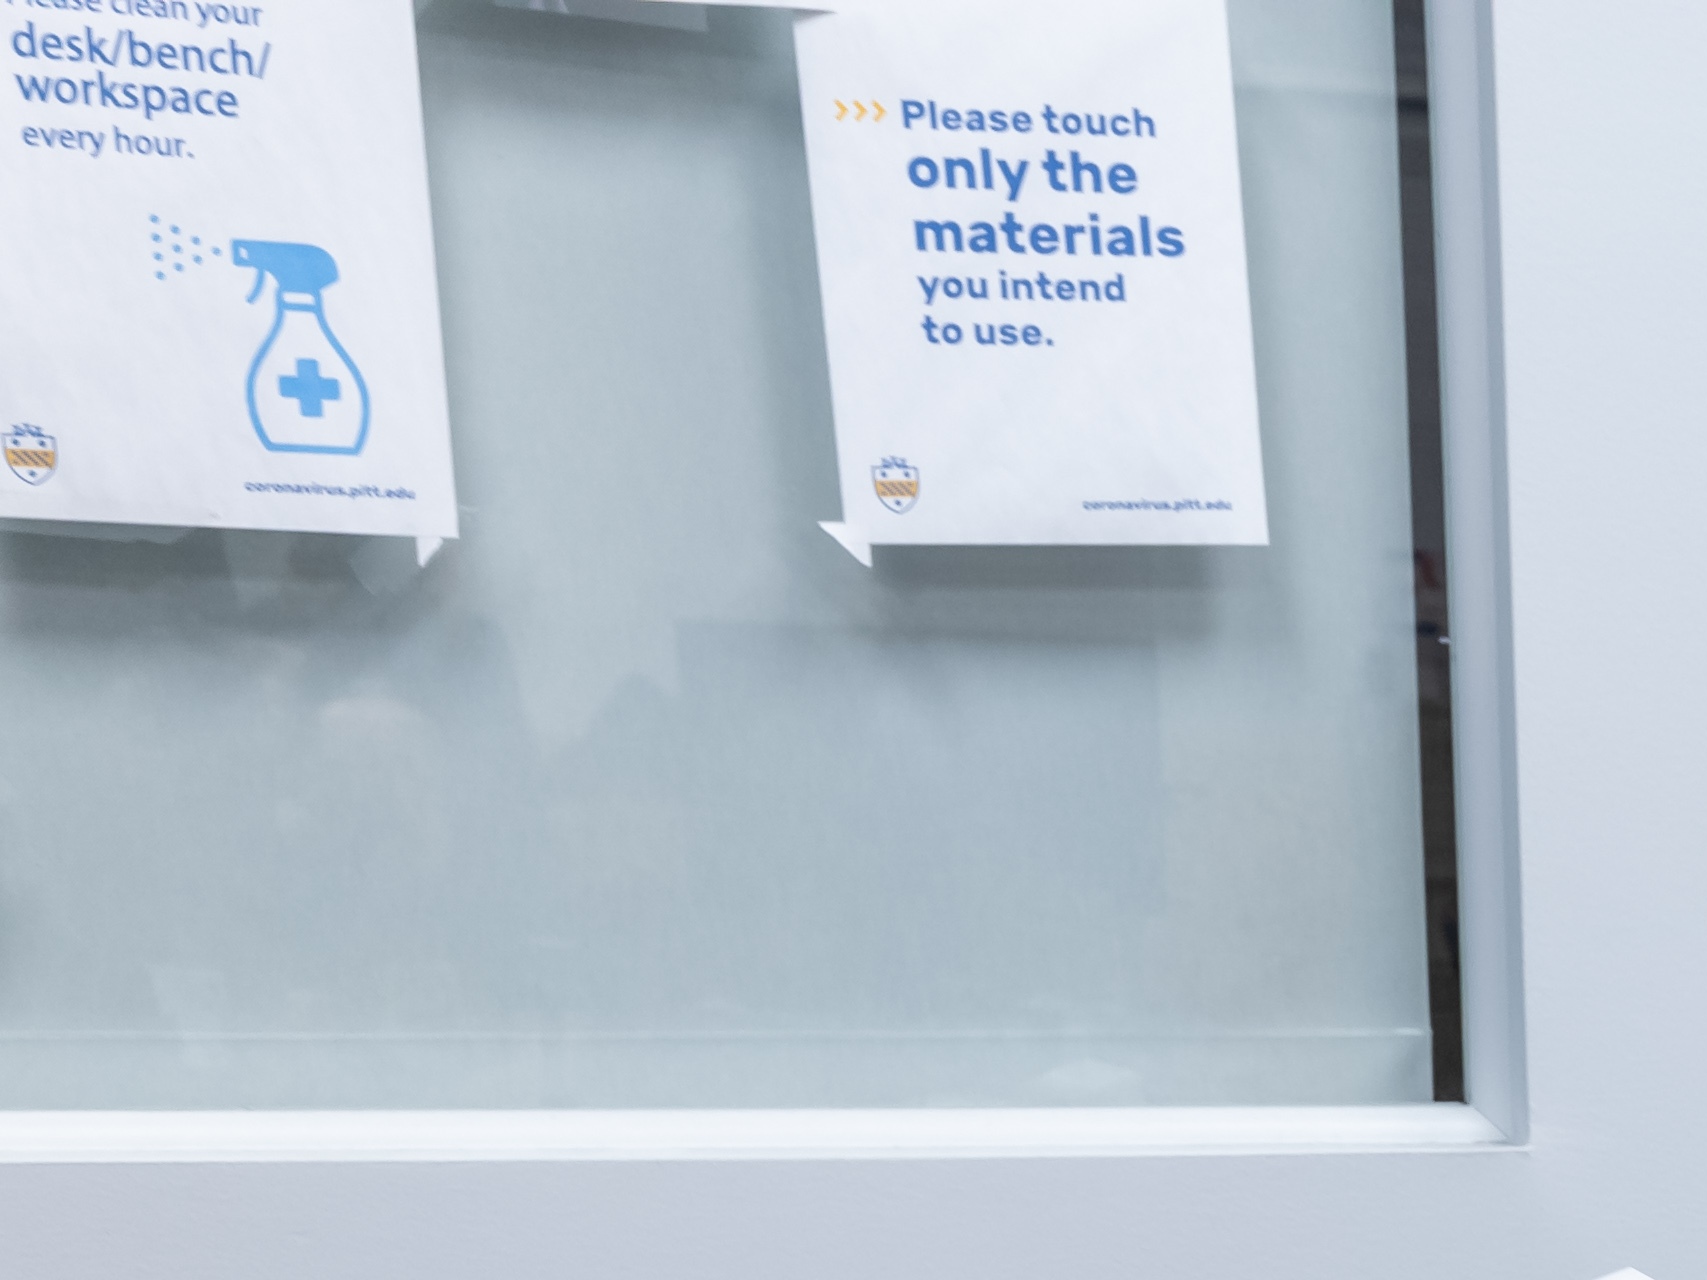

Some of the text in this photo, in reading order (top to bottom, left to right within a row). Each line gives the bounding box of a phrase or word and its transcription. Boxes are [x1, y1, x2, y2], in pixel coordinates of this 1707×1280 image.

[192, 1, 264, 28] your
[11, 20, 272, 79] desk/bench/
[14, 70, 240, 120] workspace
[901, 99, 1158, 137] Please touch
[22, 125, 195, 159] every hour.
[907, 148, 1140, 201] only the
[913, 212, 1187, 257] materials
[917, 270, 1128, 305] you intend
[922, 315, 1055, 347] to use.
